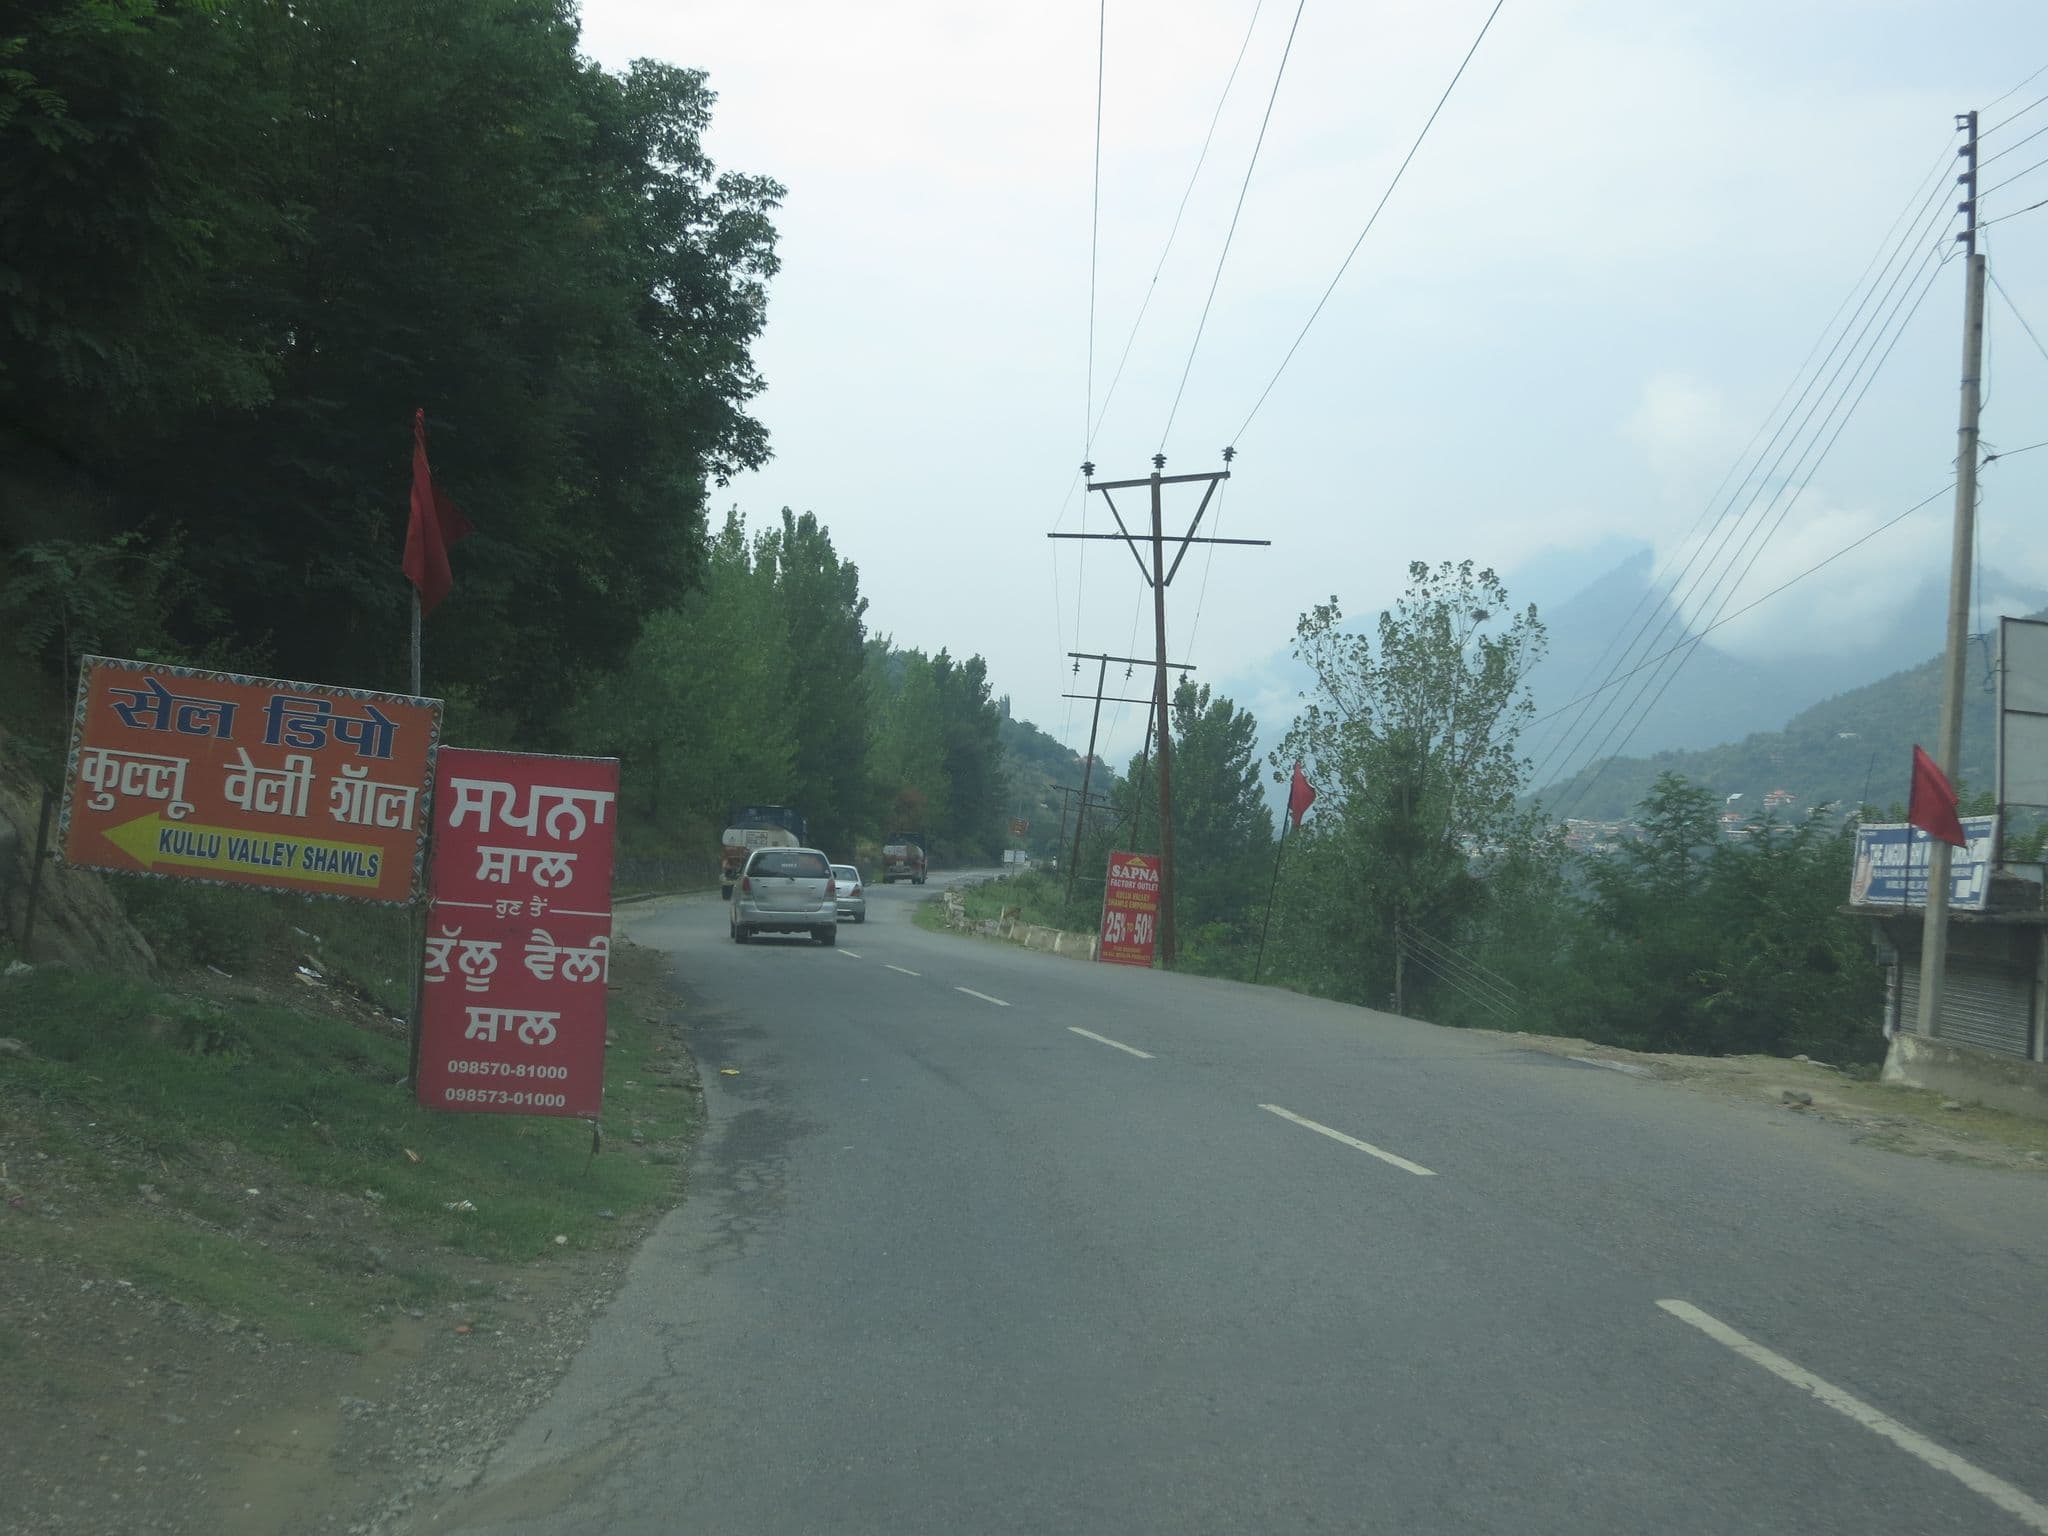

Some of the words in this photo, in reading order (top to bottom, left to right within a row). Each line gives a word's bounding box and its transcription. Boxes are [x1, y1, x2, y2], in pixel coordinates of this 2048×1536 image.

[109, 676, 239, 740] सेल
[262, 694, 400, 760] डिपो
[81, 746, 196, 820] कुल्लू
[222, 746, 316, 817] वेली
[329, 763, 420, 831] शॉल
[448, 777, 616, 841] ਸਪਨਾ
[159, 828, 222, 860] KULLU
[227, 836, 299, 869] VALLEY
[302, 846, 380, 879] SHAWLS
[476, 845, 578, 888] ਸ਼ਾਲ
[1111, 864, 1159, 882] SAPNA
[1110, 878, 1137, 889] FACTORY
[1137, 881, 1159, 892] OUTLET
[524, 928, 610, 983] ਵੈਲੀ
[464, 1005, 561, 1045] ਸ਼ਾਲ
[447, 1060, 568, 1080] 098570-81000
[445, 1088, 567, 1108] 098573-01000
